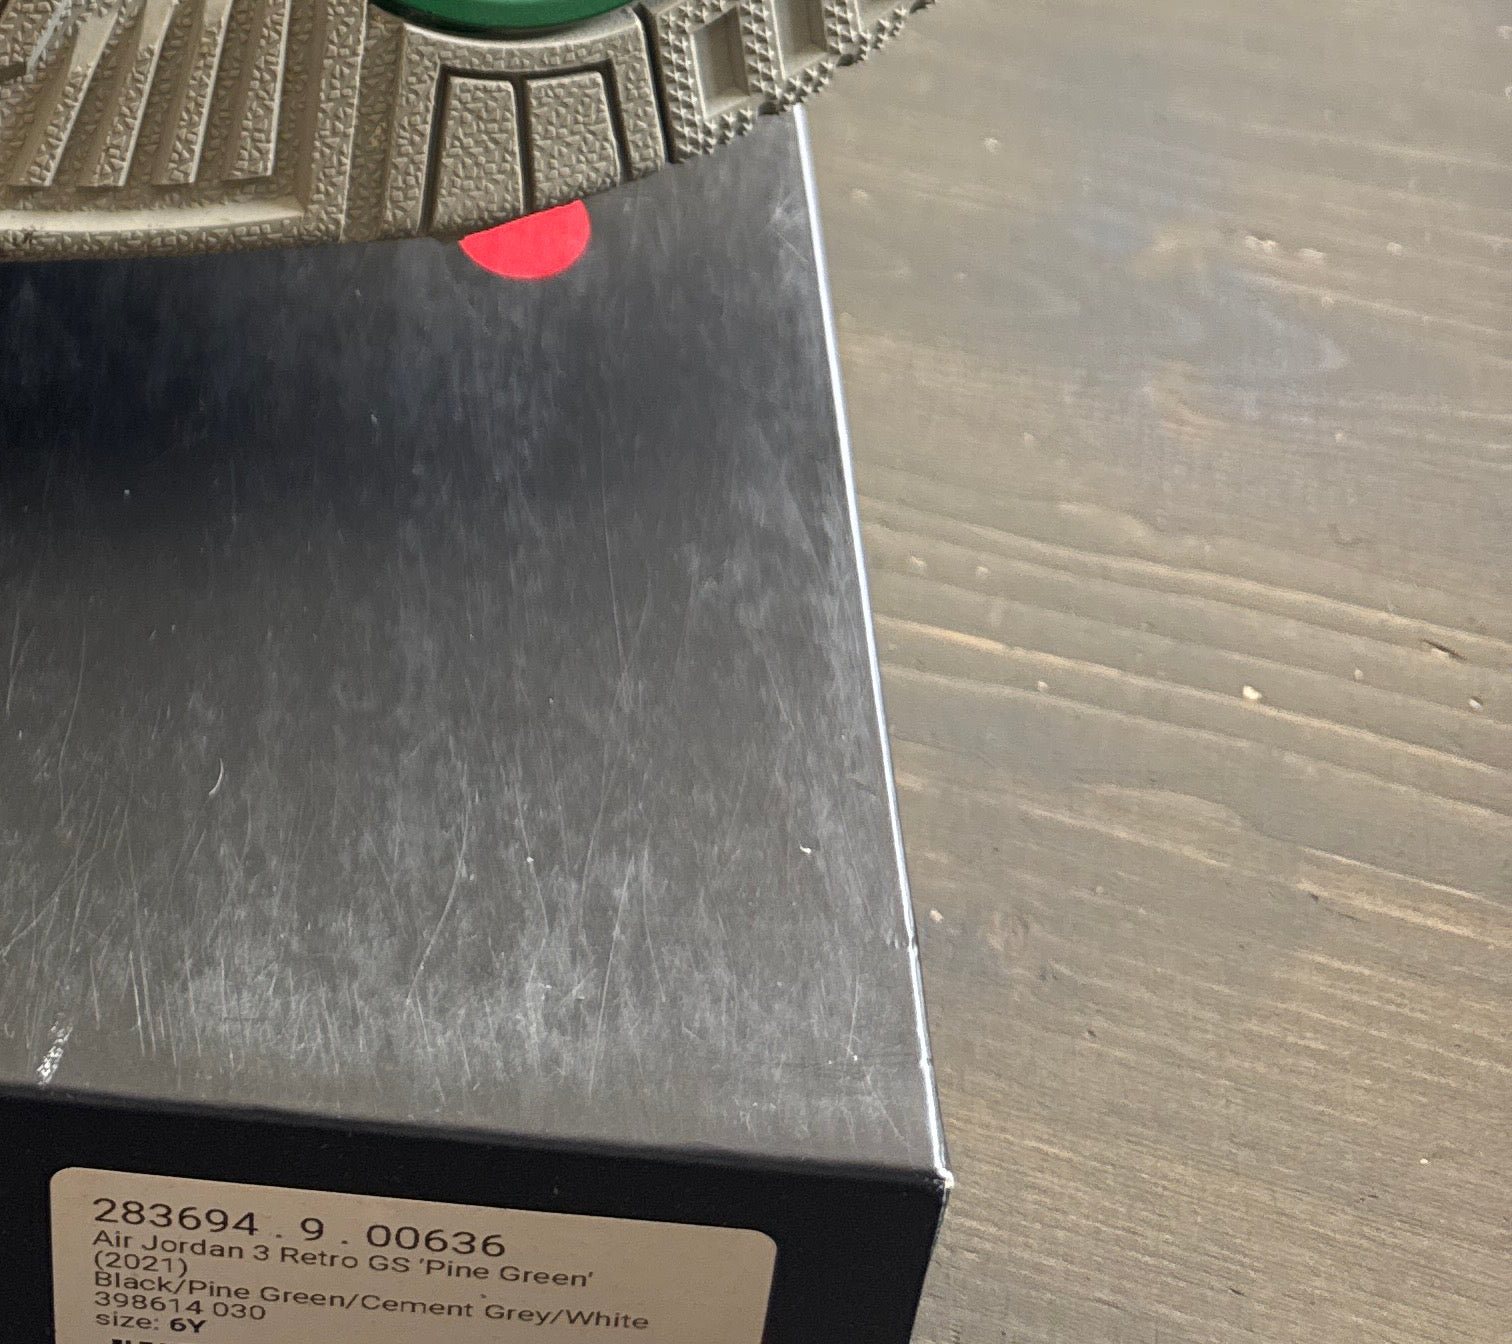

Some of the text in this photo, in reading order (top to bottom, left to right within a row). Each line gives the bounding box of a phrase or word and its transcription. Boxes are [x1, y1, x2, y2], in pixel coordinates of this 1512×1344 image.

[93, 1197, 259, 1237] 283694
[366, 1223, 506, 1258] 00636
[93, 1229, 594, 1288] Air Jordan 3 Retro GS 'Pine Green'
[94, 1250, 188, 1277] (2021)
[94, 1271, 649, 1330] Black/Pine Green/Cement Grey/White
[94, 1290, 266, 1321] 398614 030
[95, 1310, 206, 1333] size: 6Y
